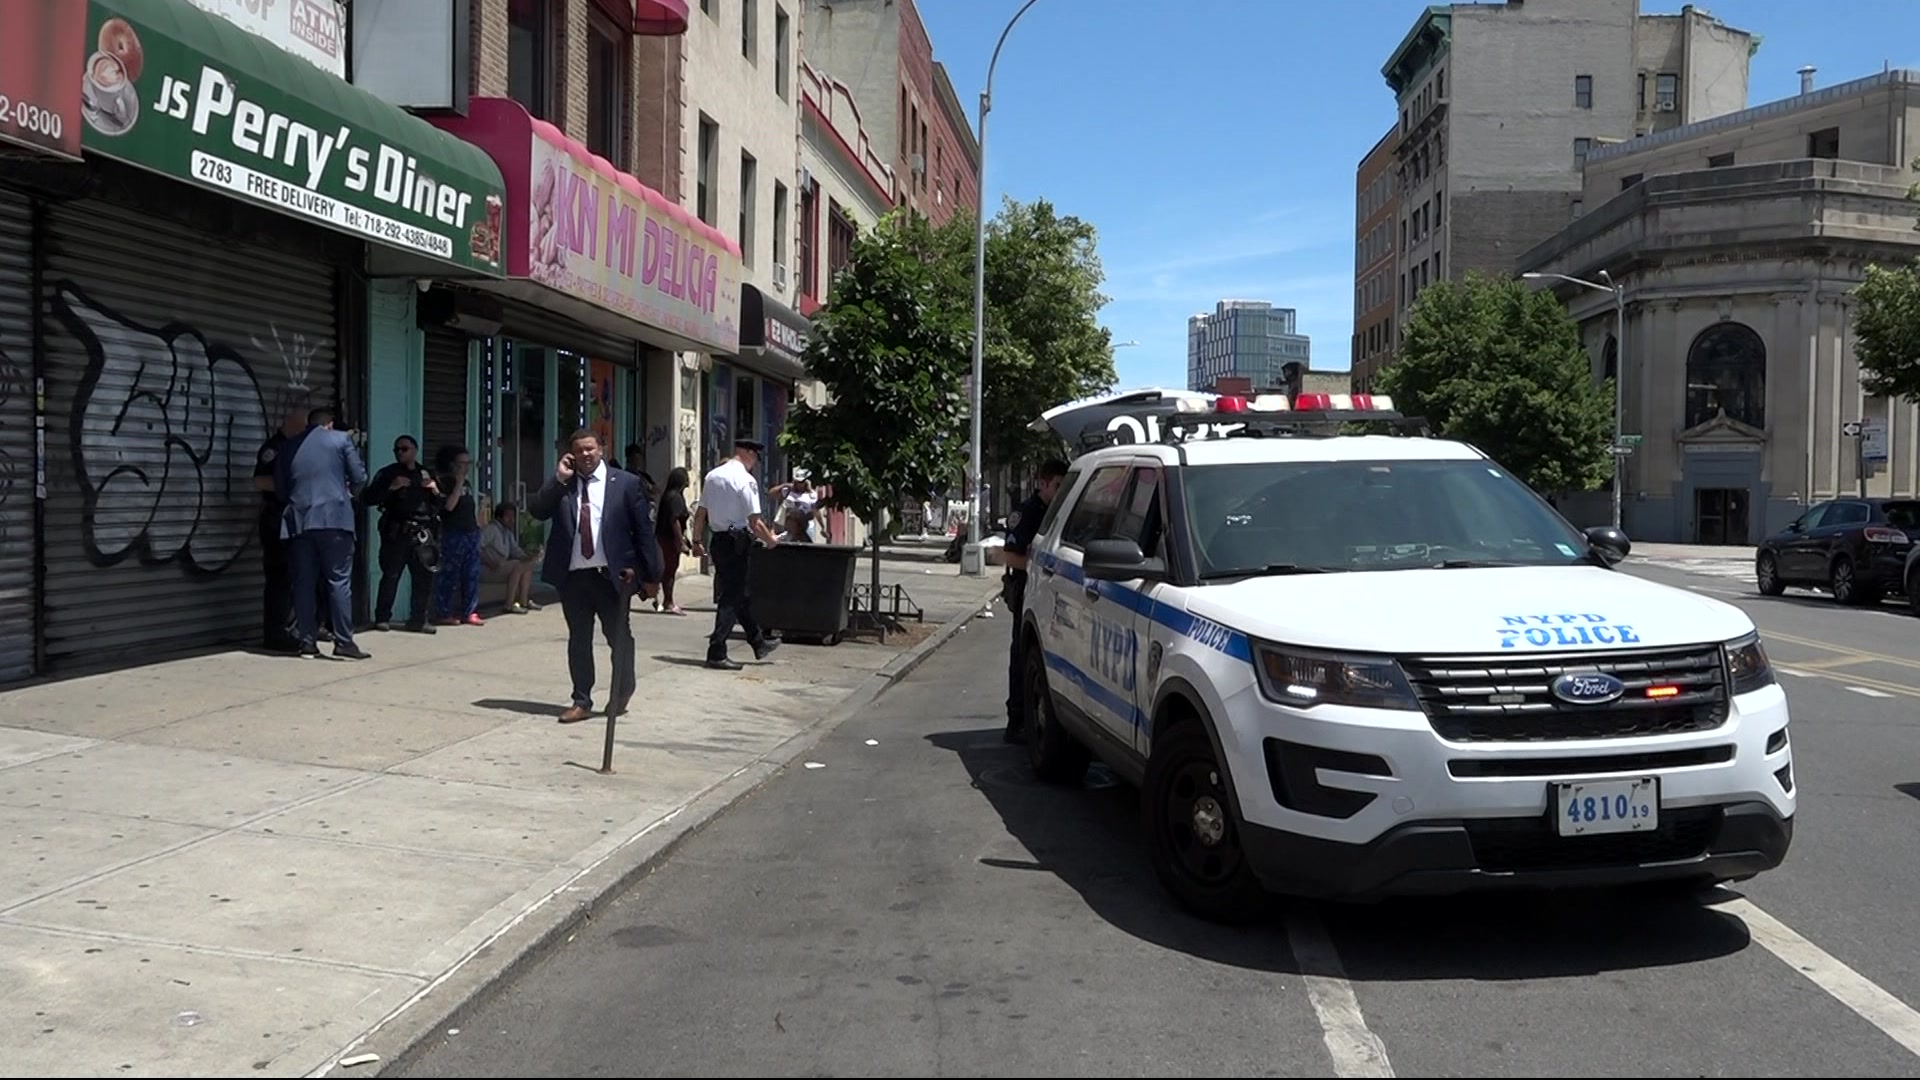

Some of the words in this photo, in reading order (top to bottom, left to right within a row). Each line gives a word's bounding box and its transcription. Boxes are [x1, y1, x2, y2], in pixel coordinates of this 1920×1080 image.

[292, 18, 336, 54] INSIDE
[293, 0, 336, 39] ATM
[153, 75, 191, 120] JS
[192, 65, 371, 191] Perry's
[374, 143, 472, 229] Diner
[200, 157, 232, 184] 2783
[247, 173, 278, 200] FREE
[281, 186, 336, 218] DELIVERY
[344, 206, 361, 227] Tel:
[605, 194, 637, 279] MI
[641, 216, 718, 315] DELICIA
[1187, 618, 1228, 652] POLICE
[1496, 625, 1641, 648] POLICE
[1499, 613, 1607, 626] NYPD
[1090, 612, 1139, 693] NYPD
[1571, 677, 1612, 696] Ford
[1567, 794, 1629, 823] 4810
[1631, 804, 1650, 819] 19
